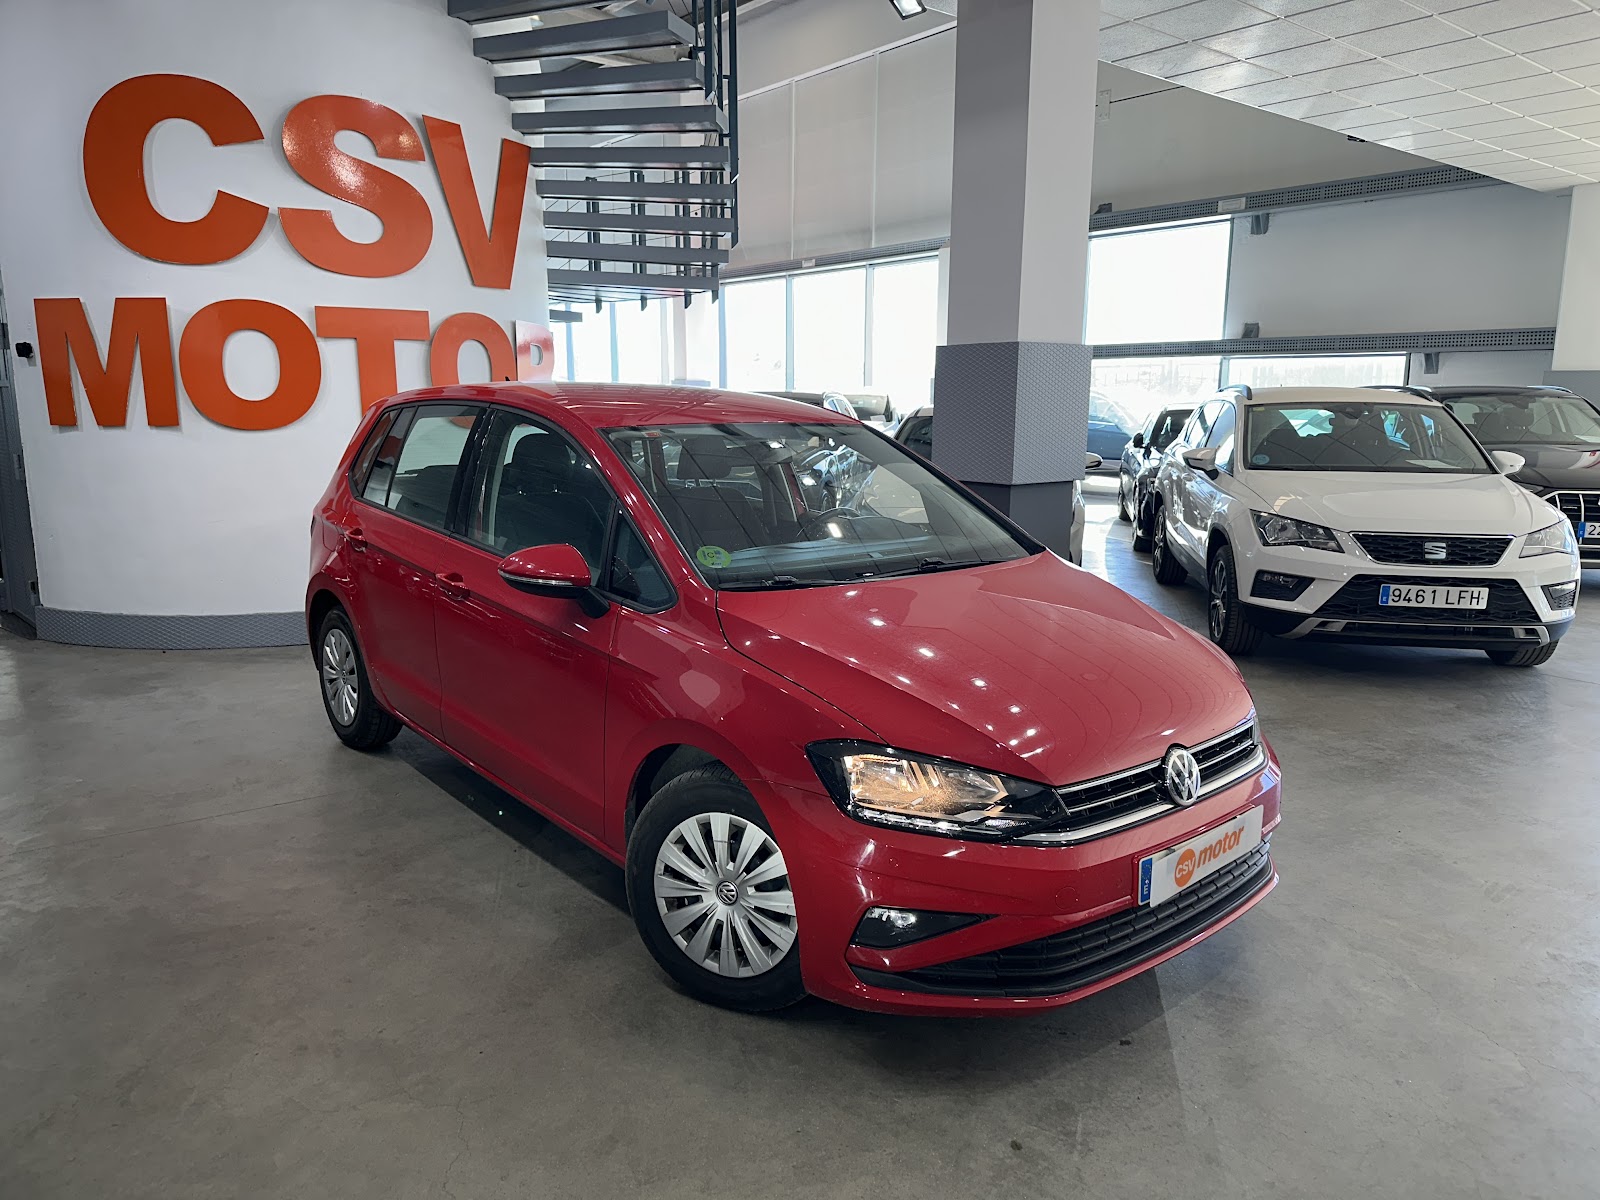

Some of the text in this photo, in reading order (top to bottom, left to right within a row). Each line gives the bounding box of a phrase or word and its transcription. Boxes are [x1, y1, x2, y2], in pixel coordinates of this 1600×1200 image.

[83, 73, 531, 290] CSV
[1391, 588, 1437, 605] 9461
[1445, 589, 1481, 606] LFH
[1197, 825, 1244, 869] motor
